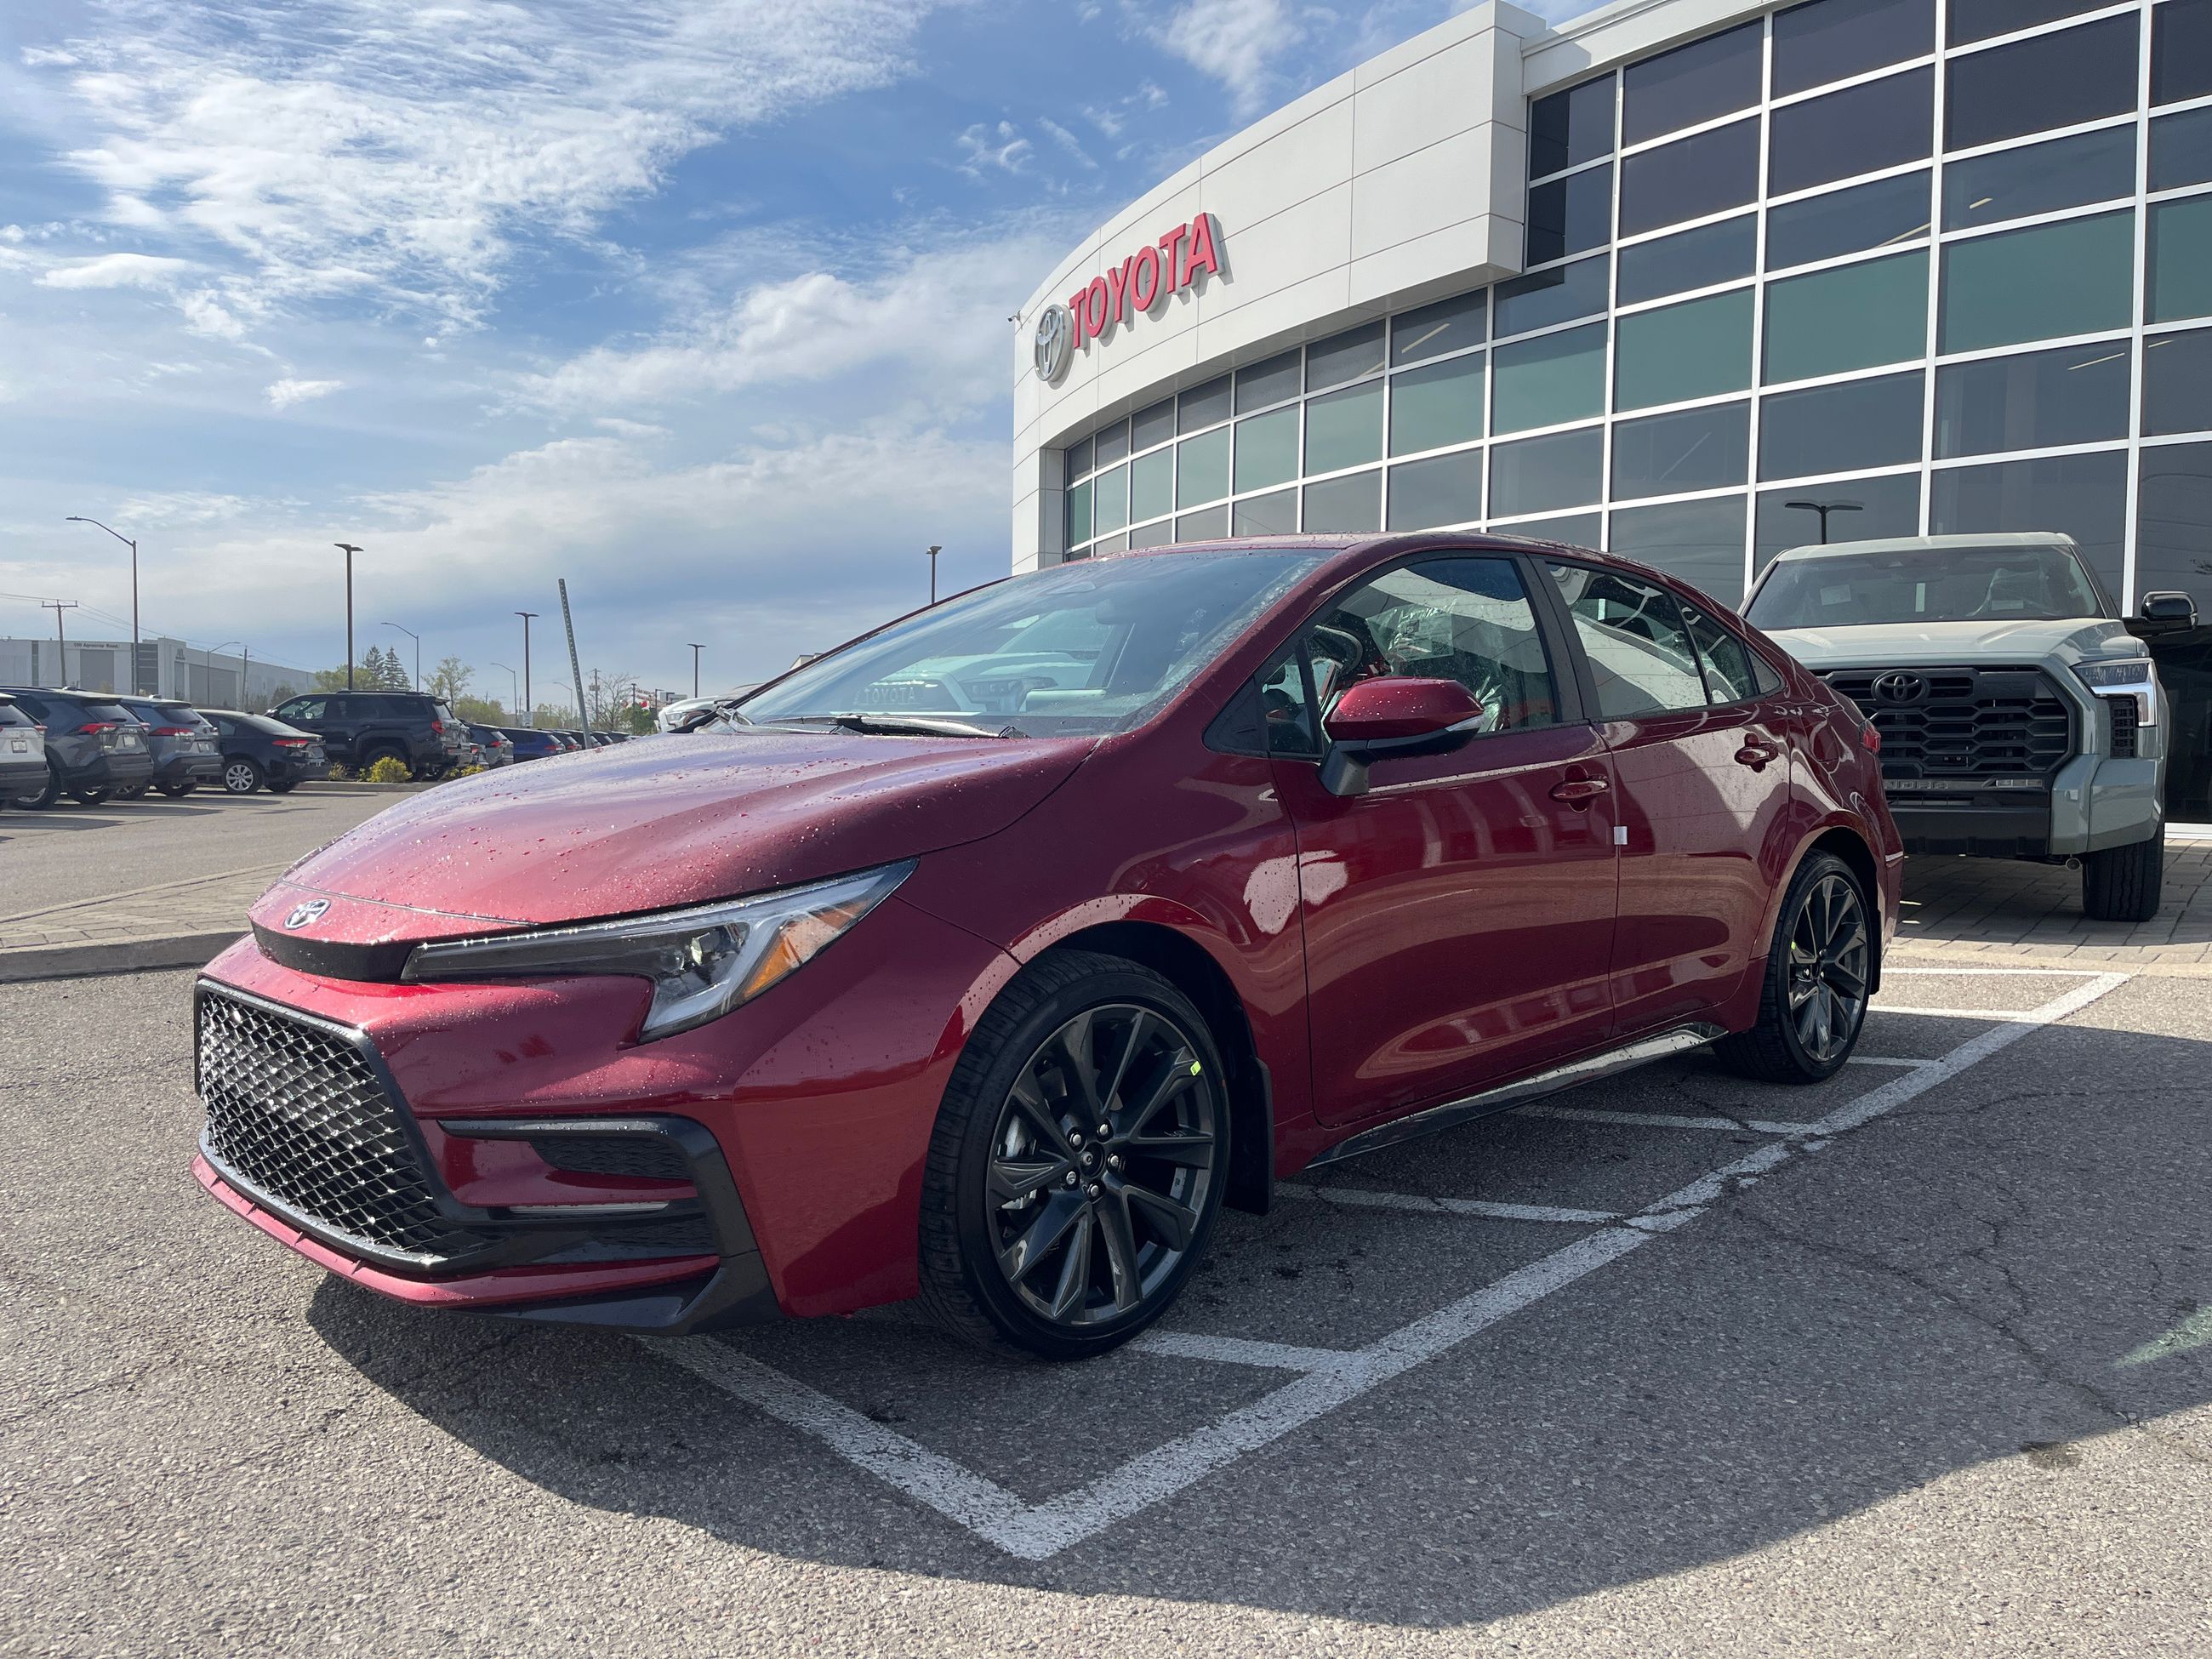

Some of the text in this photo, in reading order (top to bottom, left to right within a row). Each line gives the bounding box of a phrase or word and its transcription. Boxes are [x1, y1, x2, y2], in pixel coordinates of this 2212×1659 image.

[1069, 212, 1218, 349] TOYOTA
[864, 687, 916, 704] TOYOTA
[1884, 780, 1949, 790] NDRA
